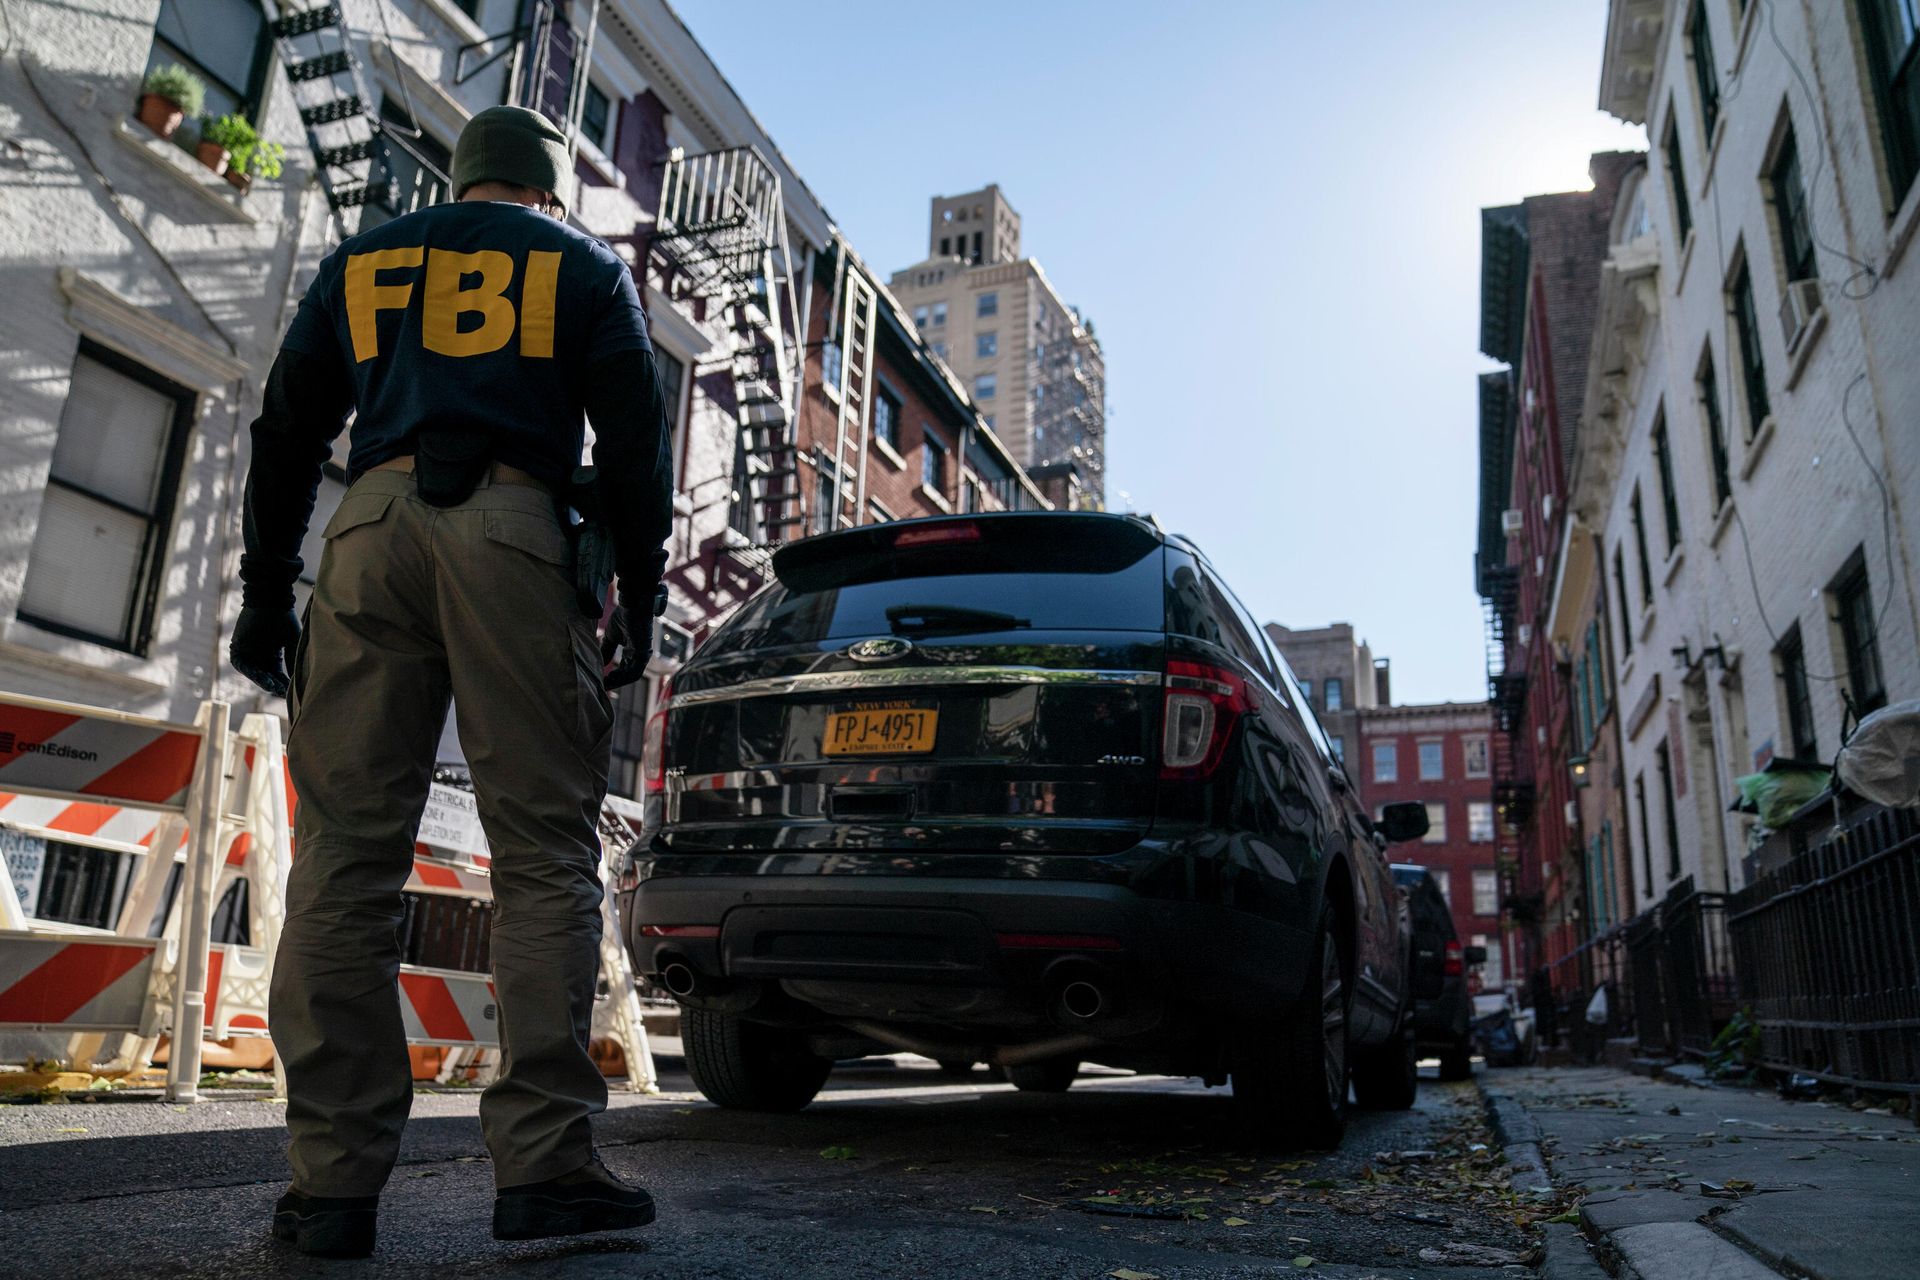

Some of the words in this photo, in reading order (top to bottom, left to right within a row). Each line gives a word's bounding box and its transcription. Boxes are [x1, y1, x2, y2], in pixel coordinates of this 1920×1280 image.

[344, 246, 563, 363] FBI
[860, 639, 898, 656] Ford
[855, 702, 880, 711] NEW
[884, 700, 912, 710] YORK
[17, 741, 98, 762] conEdison
[1097, 754, 1145, 765] 4WD
[429, 788, 467, 809] LECTRICAL
